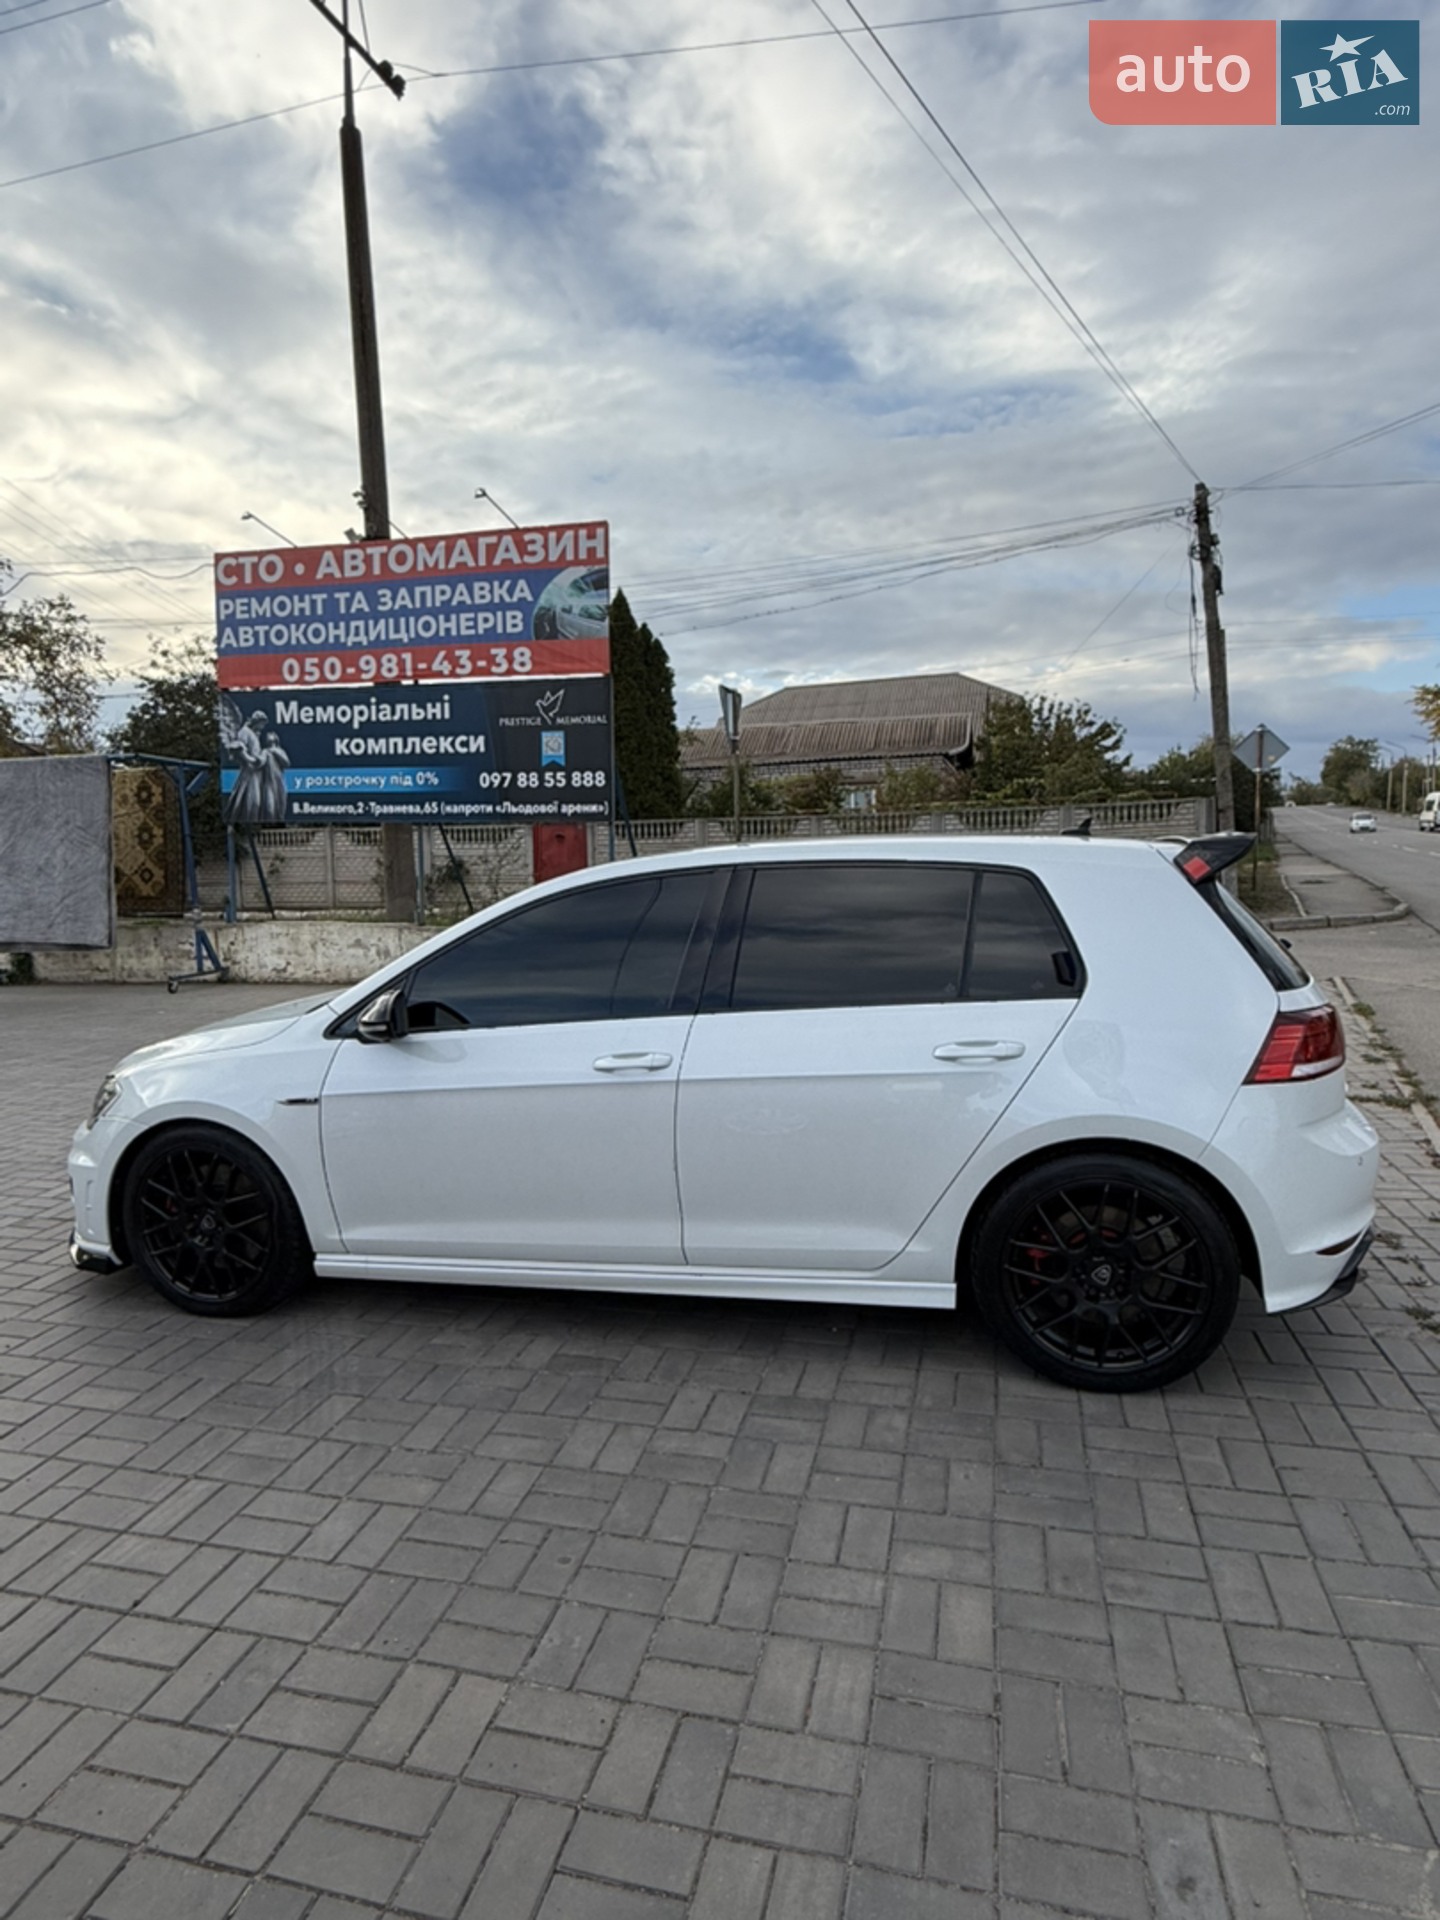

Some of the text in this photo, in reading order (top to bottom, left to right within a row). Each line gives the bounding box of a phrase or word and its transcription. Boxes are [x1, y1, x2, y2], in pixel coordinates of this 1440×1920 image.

[216, 526, 605, 586] СТО АВТОМАГАЗИН
[219, 579, 534, 620] РЕМОНТ ТА ЗАПРАВКА
[219, 610, 524, 648] АВТОКОНДИЦІОНЕРІВ
[281, 646, 533, 683] 050-981-43-38
[275, 693, 450, 730] Меморіальні
[498, 714, 608, 727] PRESTIGE MEMORIAL
[334, 734, 486, 756] комплекси
[294, 771, 440, 789] у розстрочку під 0%
[479, 770, 606, 789] 097 88 55 888
